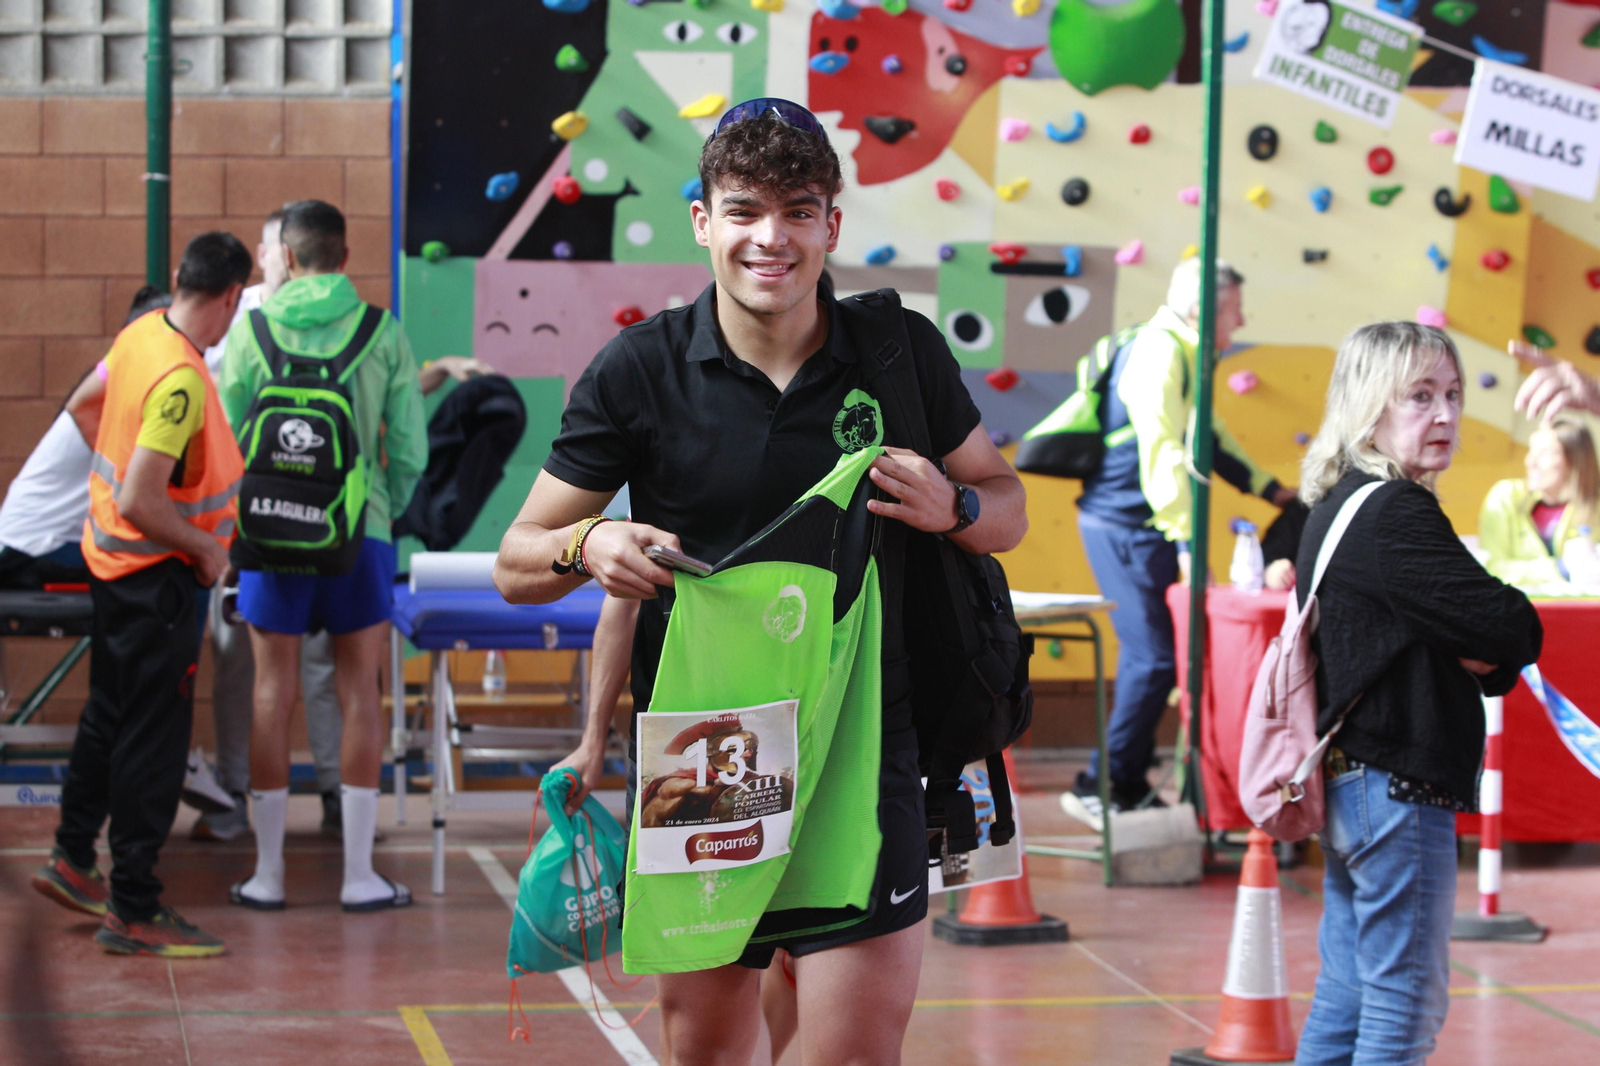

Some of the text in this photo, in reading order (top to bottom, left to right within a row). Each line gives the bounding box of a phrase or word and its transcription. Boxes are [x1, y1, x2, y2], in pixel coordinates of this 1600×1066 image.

[1341, 11, 1408, 50] ENTREGA
[1357, 38, 1381, 60] DE
[1323, 45, 1400, 89] DORSALES
[1268, 54, 1389, 118] INFANTILES
[1491, 75, 1600, 121] DORSALES
[1484, 119, 1585, 166] MILLAS
[685, 735, 746, 788] 13
[734, 788, 783, 801] CARRERA
[735, 774, 783, 794] XIII
[733, 812, 749, 820] DEL
[735, 795, 781, 808] POPULAR
[695, 831, 758, 855] Caparrós
